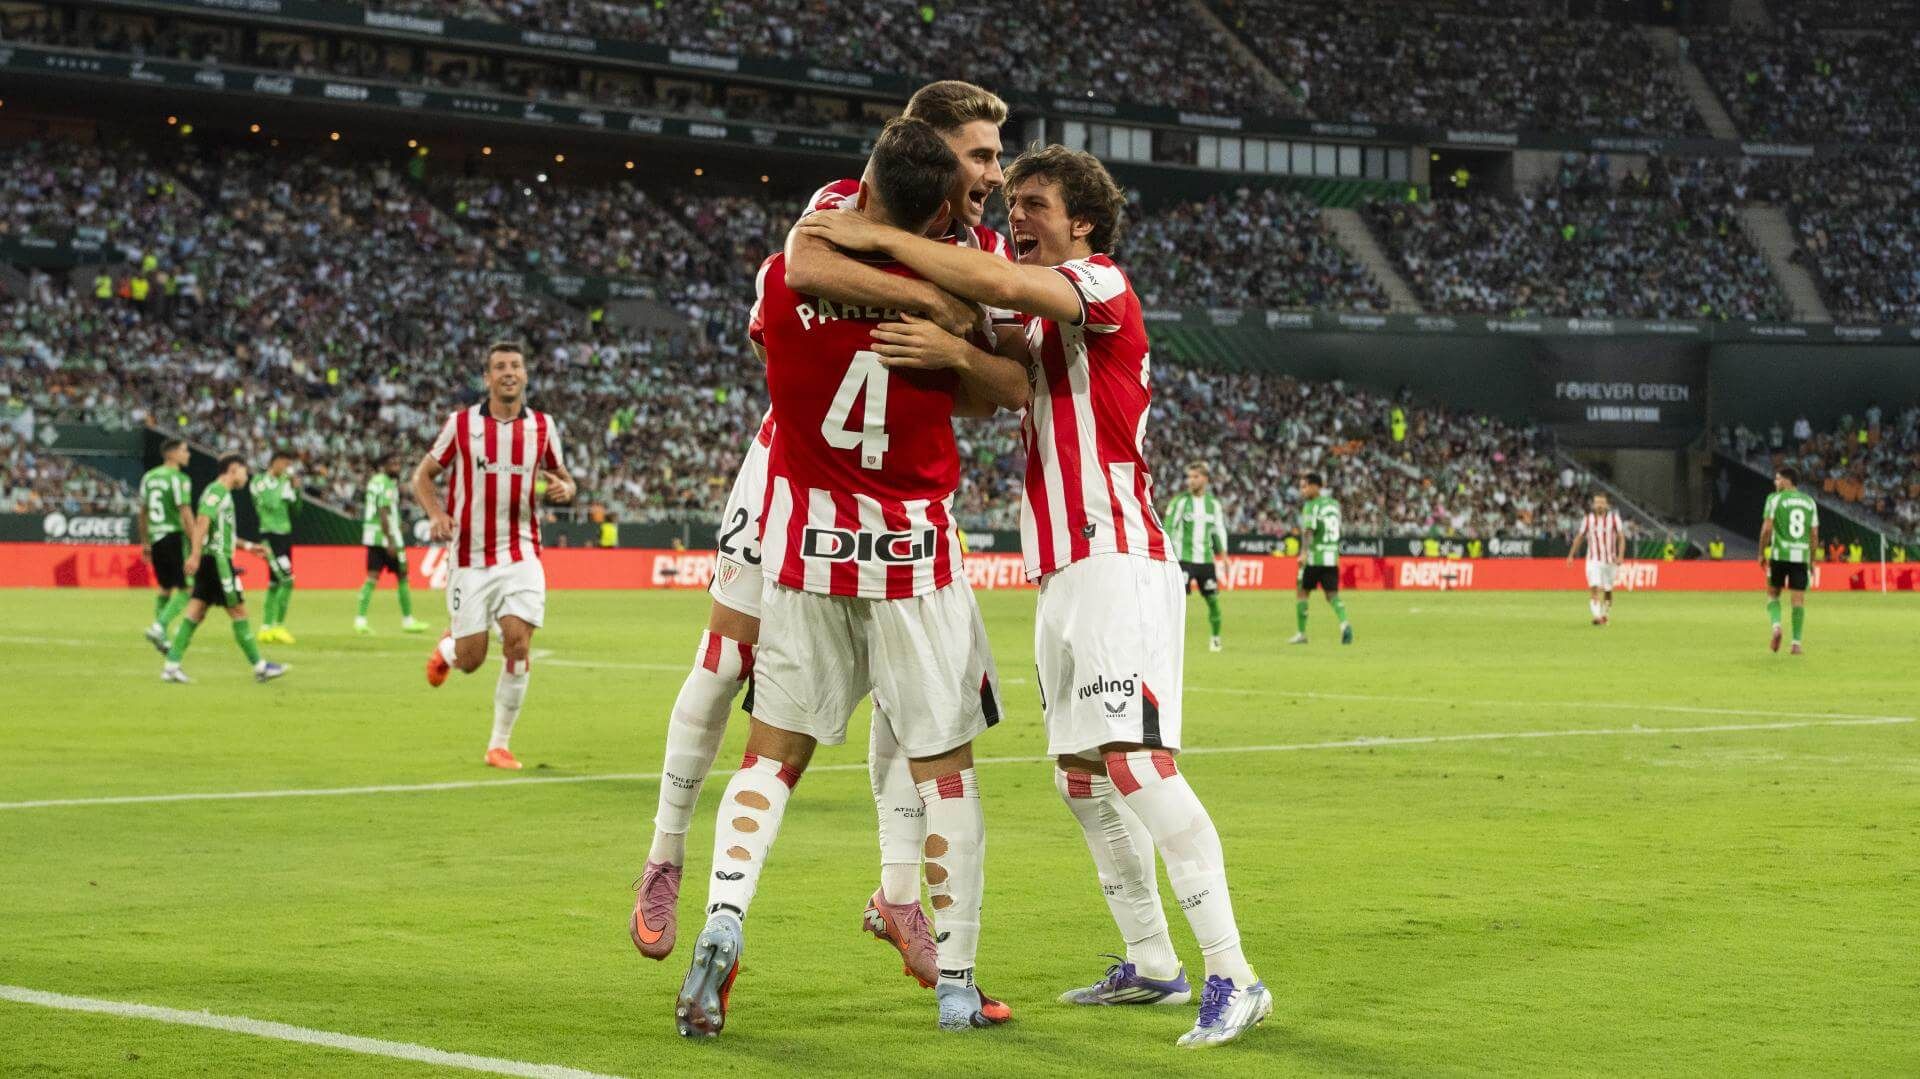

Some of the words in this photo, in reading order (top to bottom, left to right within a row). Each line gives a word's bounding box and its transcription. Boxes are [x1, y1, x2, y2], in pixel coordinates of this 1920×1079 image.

[1556, 382, 1634, 401] FOREVER
[1638, 383, 1689, 402] GREEN
[820, 350, 889, 471] 4
[68, 517, 131, 537] GREE
[1788, 508, 1805, 539] 8
[803, 529, 935, 562] DIGI
[964, 556, 1026, 590] ERYETI
[453, 587, 461, 611] 6
[1078, 674, 1138, 700] vueling
